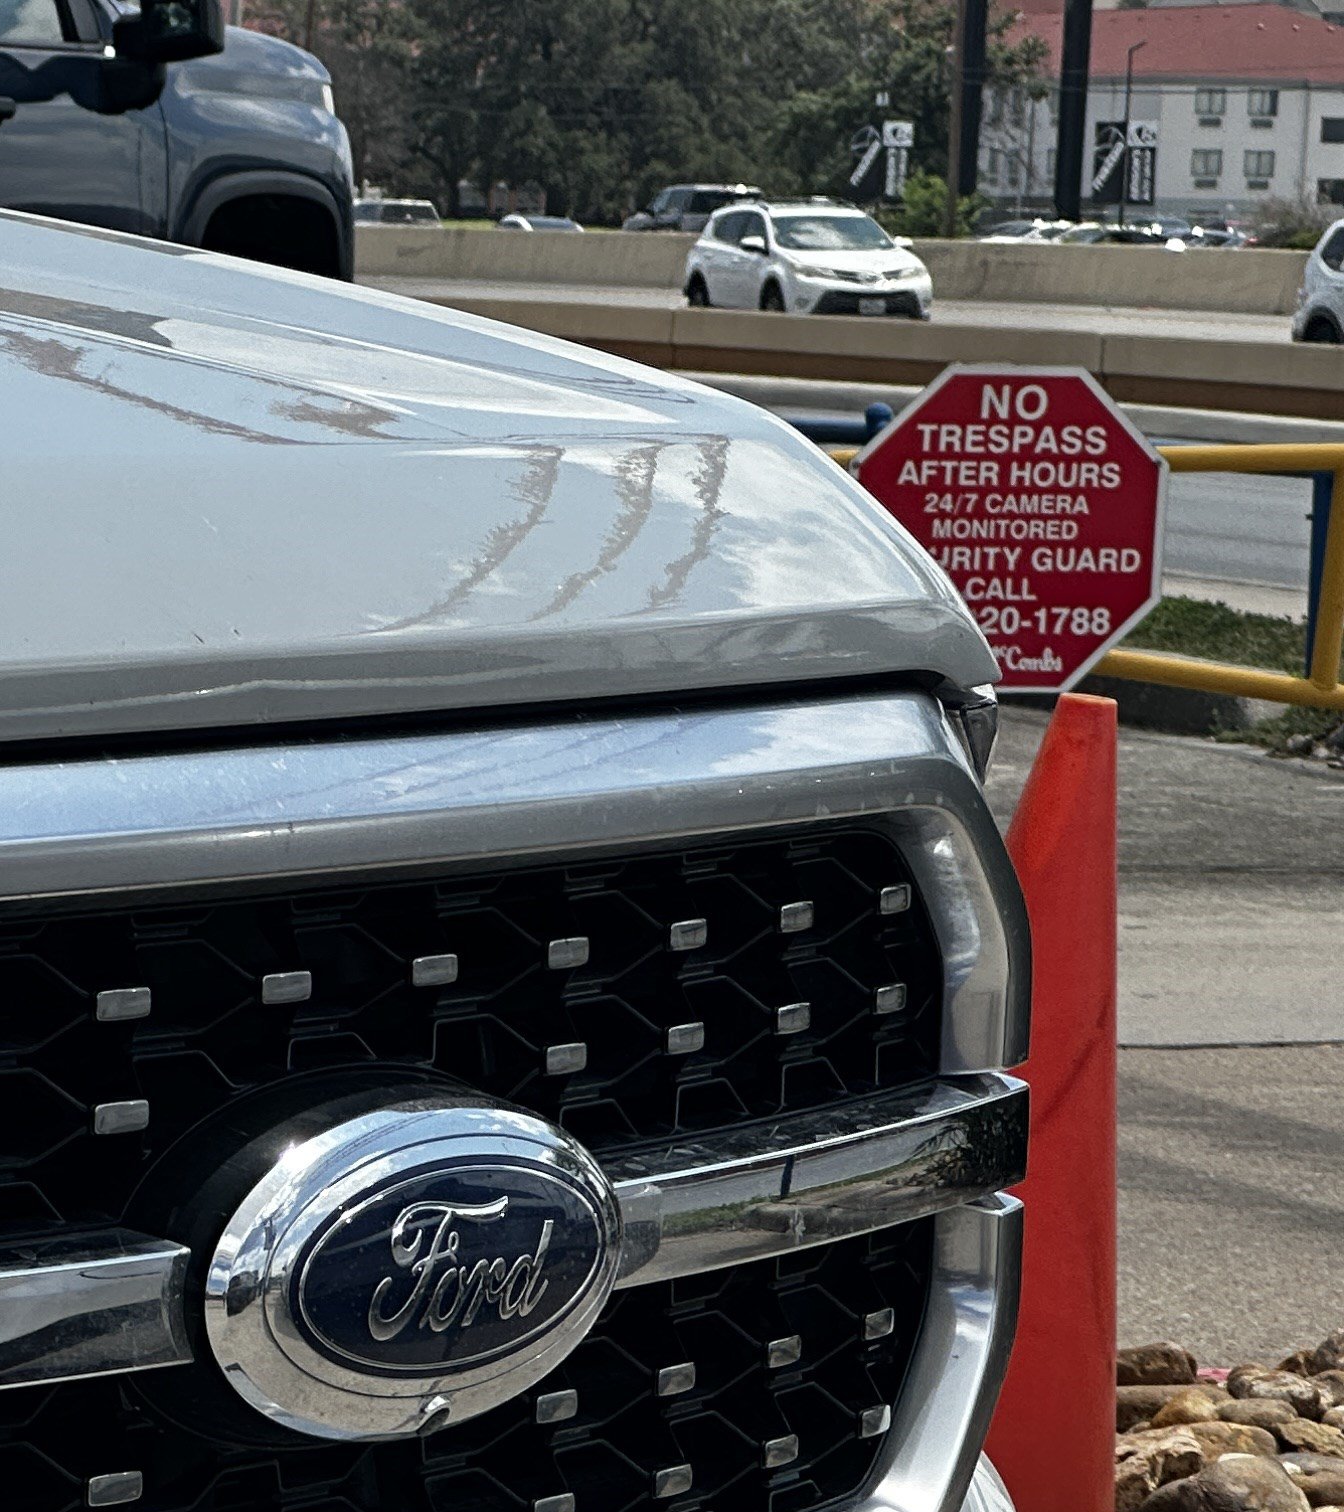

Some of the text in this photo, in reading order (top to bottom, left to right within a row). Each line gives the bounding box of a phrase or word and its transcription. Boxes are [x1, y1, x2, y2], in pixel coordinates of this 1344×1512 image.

[980, 384, 1049, 421] NO
[917, 423, 1108, 455] TRESPASS
[897, 460, 1121, 488] AFTER HOURS
[923, 493, 1090, 515] 24/7 CAMERA
[932, 518, 1079, 540] MONITORED
[931, 547, 1141, 573] URITY GUARD
[965, 577, 1037, 600] CALL
[973, 606, 1110, 636] 20-1788
[369, 1196, 554, 1341] Ford
